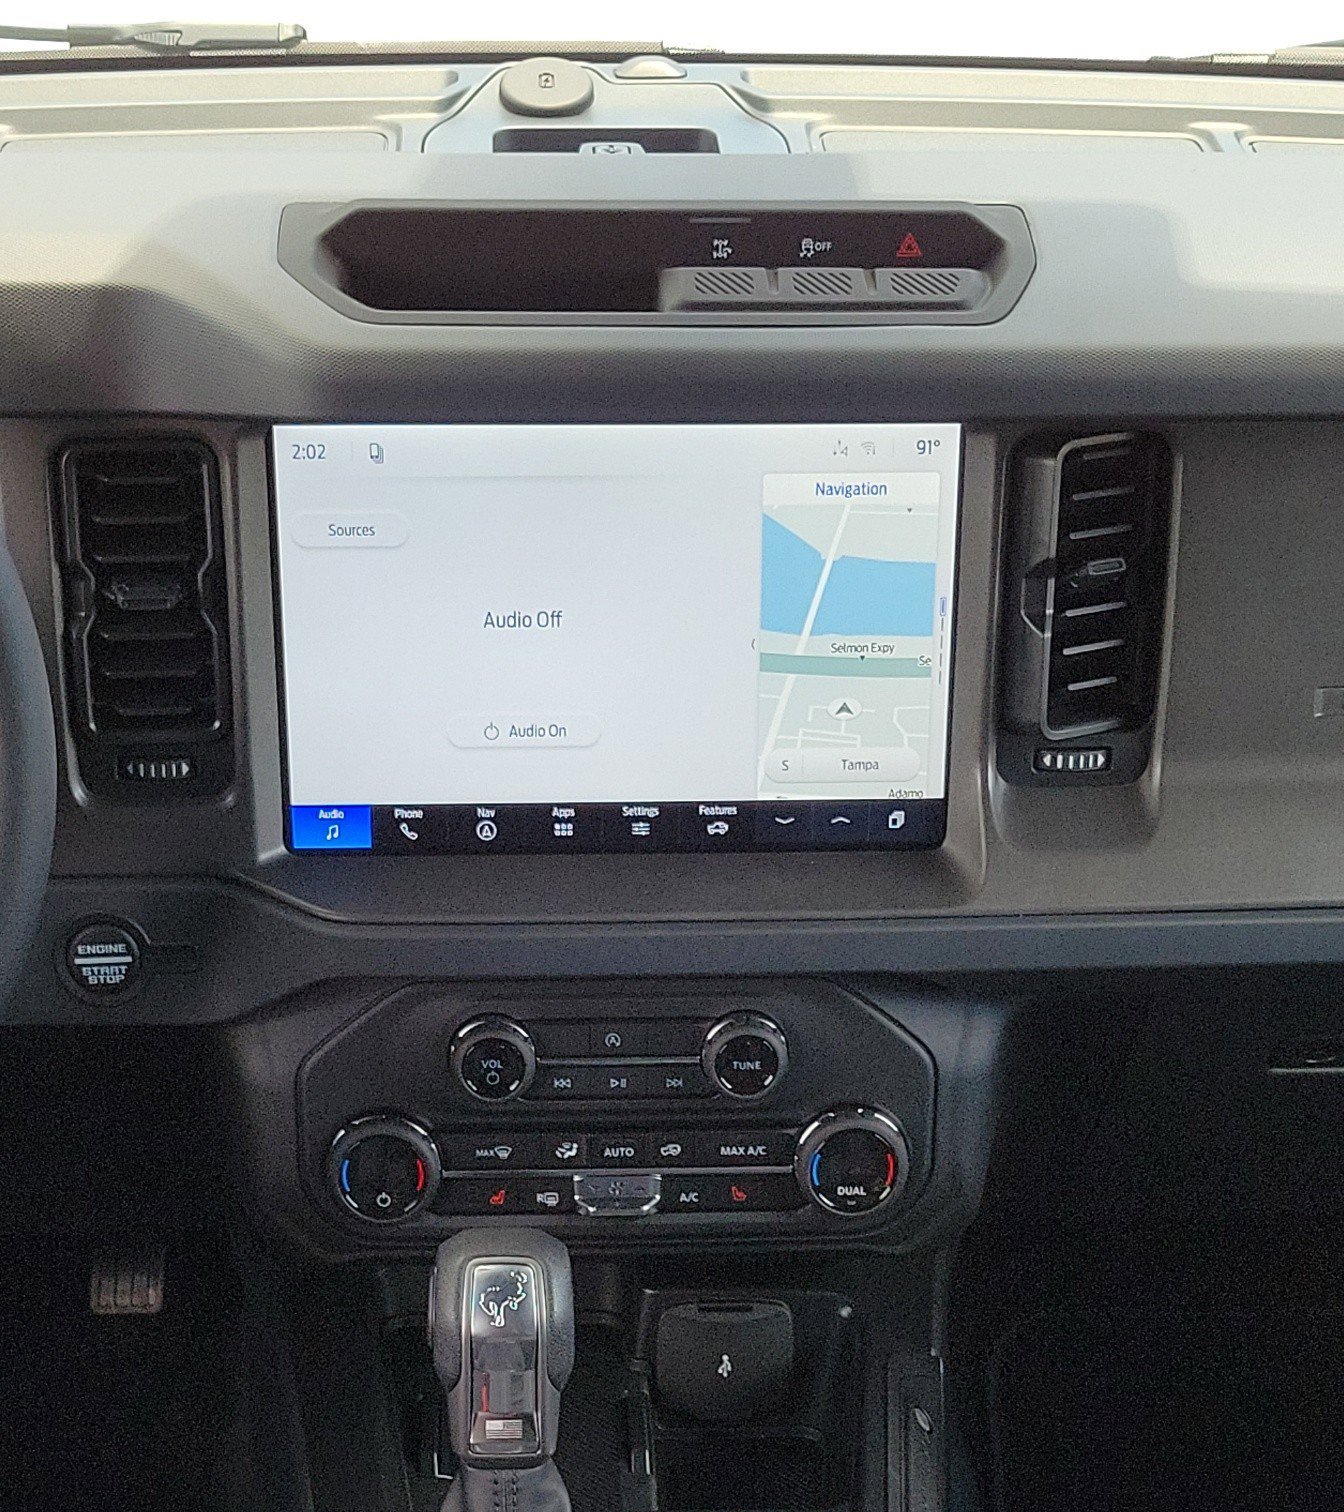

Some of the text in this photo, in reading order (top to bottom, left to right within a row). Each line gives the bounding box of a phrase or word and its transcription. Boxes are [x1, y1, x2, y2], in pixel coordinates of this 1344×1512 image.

[814, 242, 832, 251] OFF
[292, 444, 326, 460] 2:02
[916, 439, 941, 455] 91°
[815, 481, 888, 498] Navigation
[328, 523, 376, 537] Sources
[483, 610, 563, 628] Audio Off
[831, 642, 895, 655] Selmon Expy
[918, 655, 932, 666] Se
[509, 724, 567, 738] Audio On
[781, 760, 789, 771] S
[841, 759, 879, 772] Tampa
[318, 809, 345, 819] Audio
[394, 808, 424, 819] Phone
[477, 808, 496, 818] Nav
[552, 807, 575, 819] Apps
[622, 806, 660, 818] Settings
[698, 805, 738, 816] Features
[77, 943, 127, 955] ENGINE
[82, 965, 128, 976] START
[88, 975, 125, 985] STOP
[481, 1059, 503, 1069] VOL
[732, 1061, 762, 1071] TUNE
[476, 1148, 494, 1158] MAX
[604, 1147, 635, 1158] AUTO
[720, 1145, 767, 1157] MAX A/C
[837, 1186, 867, 1197] DUAL
[679, 1192, 699, 1203] A/C
